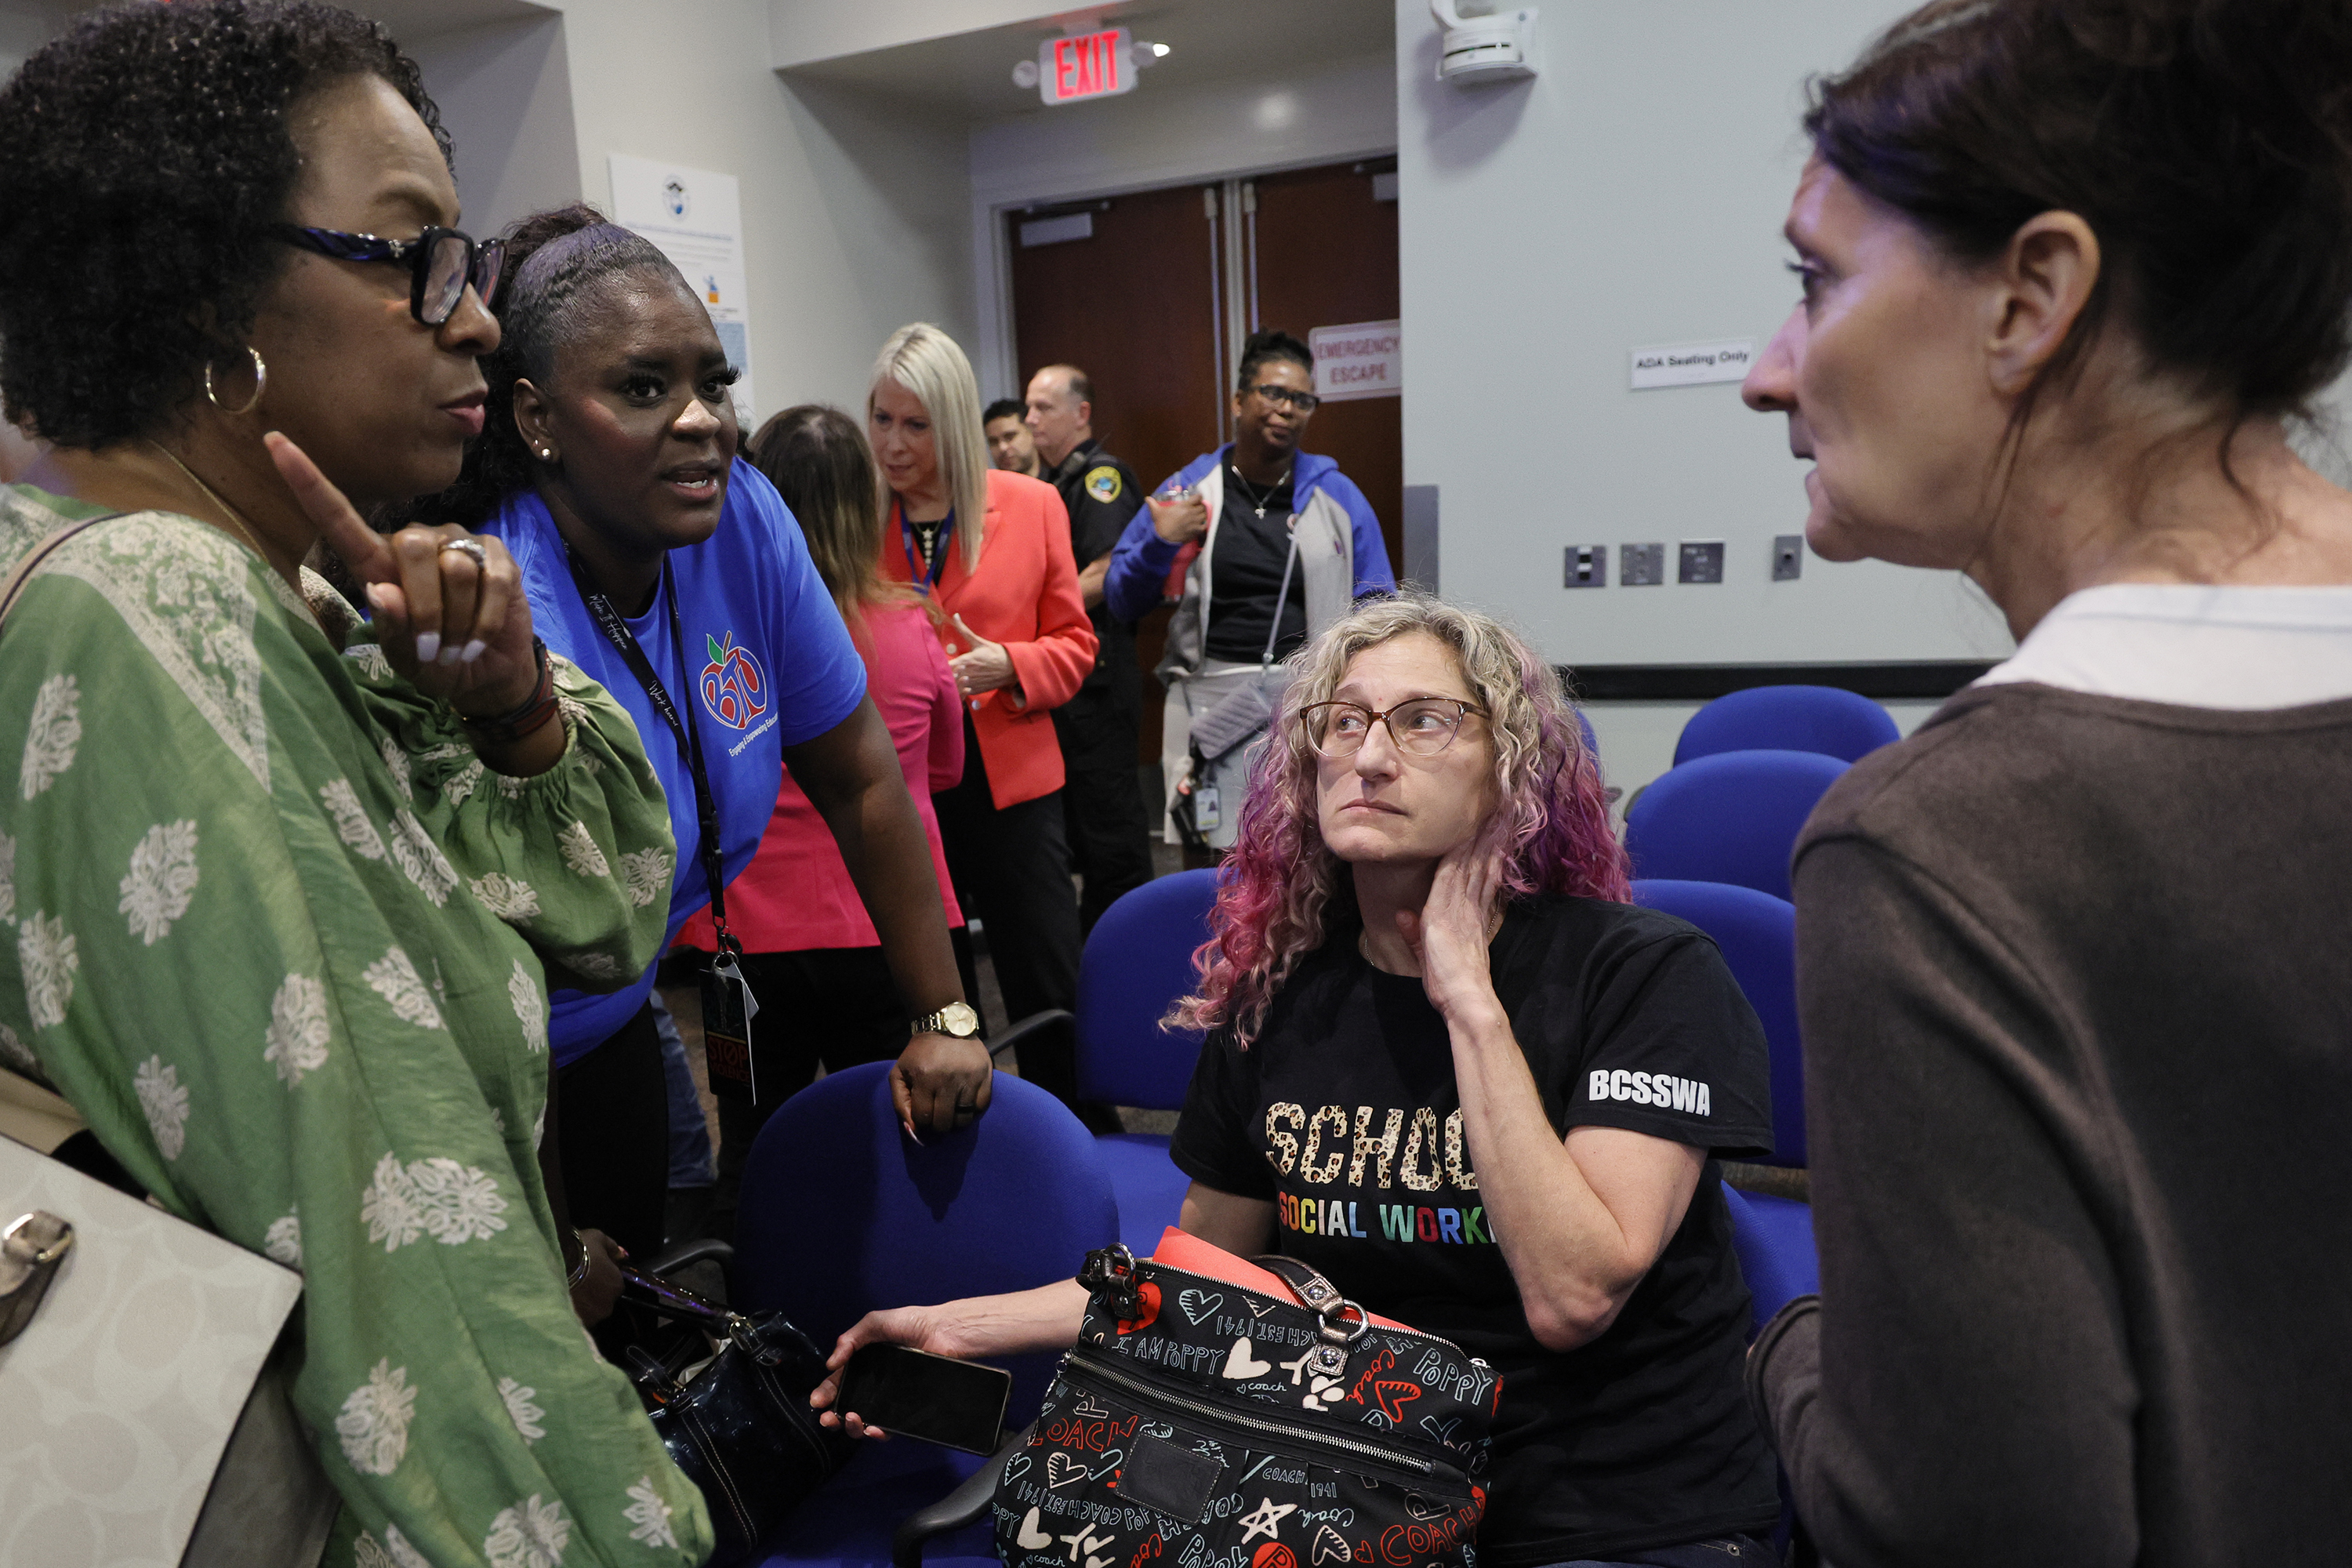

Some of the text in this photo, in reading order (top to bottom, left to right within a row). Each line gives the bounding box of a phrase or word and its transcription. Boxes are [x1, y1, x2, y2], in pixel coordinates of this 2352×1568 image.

[1054, 30, 1120, 100] EXIT
[1317, 336, 1400, 360] EMERGENCY
[1636, 350, 1748, 368] ADA Seating Only
[1330, 362, 1386, 384] ESCAPE
[649, 680, 666, 706] Work
[746, 723, 768, 742] Empowering
[708, 1036, 749, 1067] STOP
[710, 1060, 751, 1083] VIOLENCE
[1589, 1069, 1711, 1116] BCSSWA
[1279, 1191, 1497, 1244] SOCIAL WORK
[1217, 1315, 1255, 1338] 1941
[1112, 1337, 1225, 1375] I AM POPPY
[1248, 1381, 1287, 1392] coach
[1413, 1348, 1493, 1406] POPPY
[1262, 1467, 1338, 1498] COACH 1941
[1068, 1499, 1122, 1526] COACH
[1380, 1505, 1477, 1566] COACH
[1034, 1555, 1066, 1568] coach
